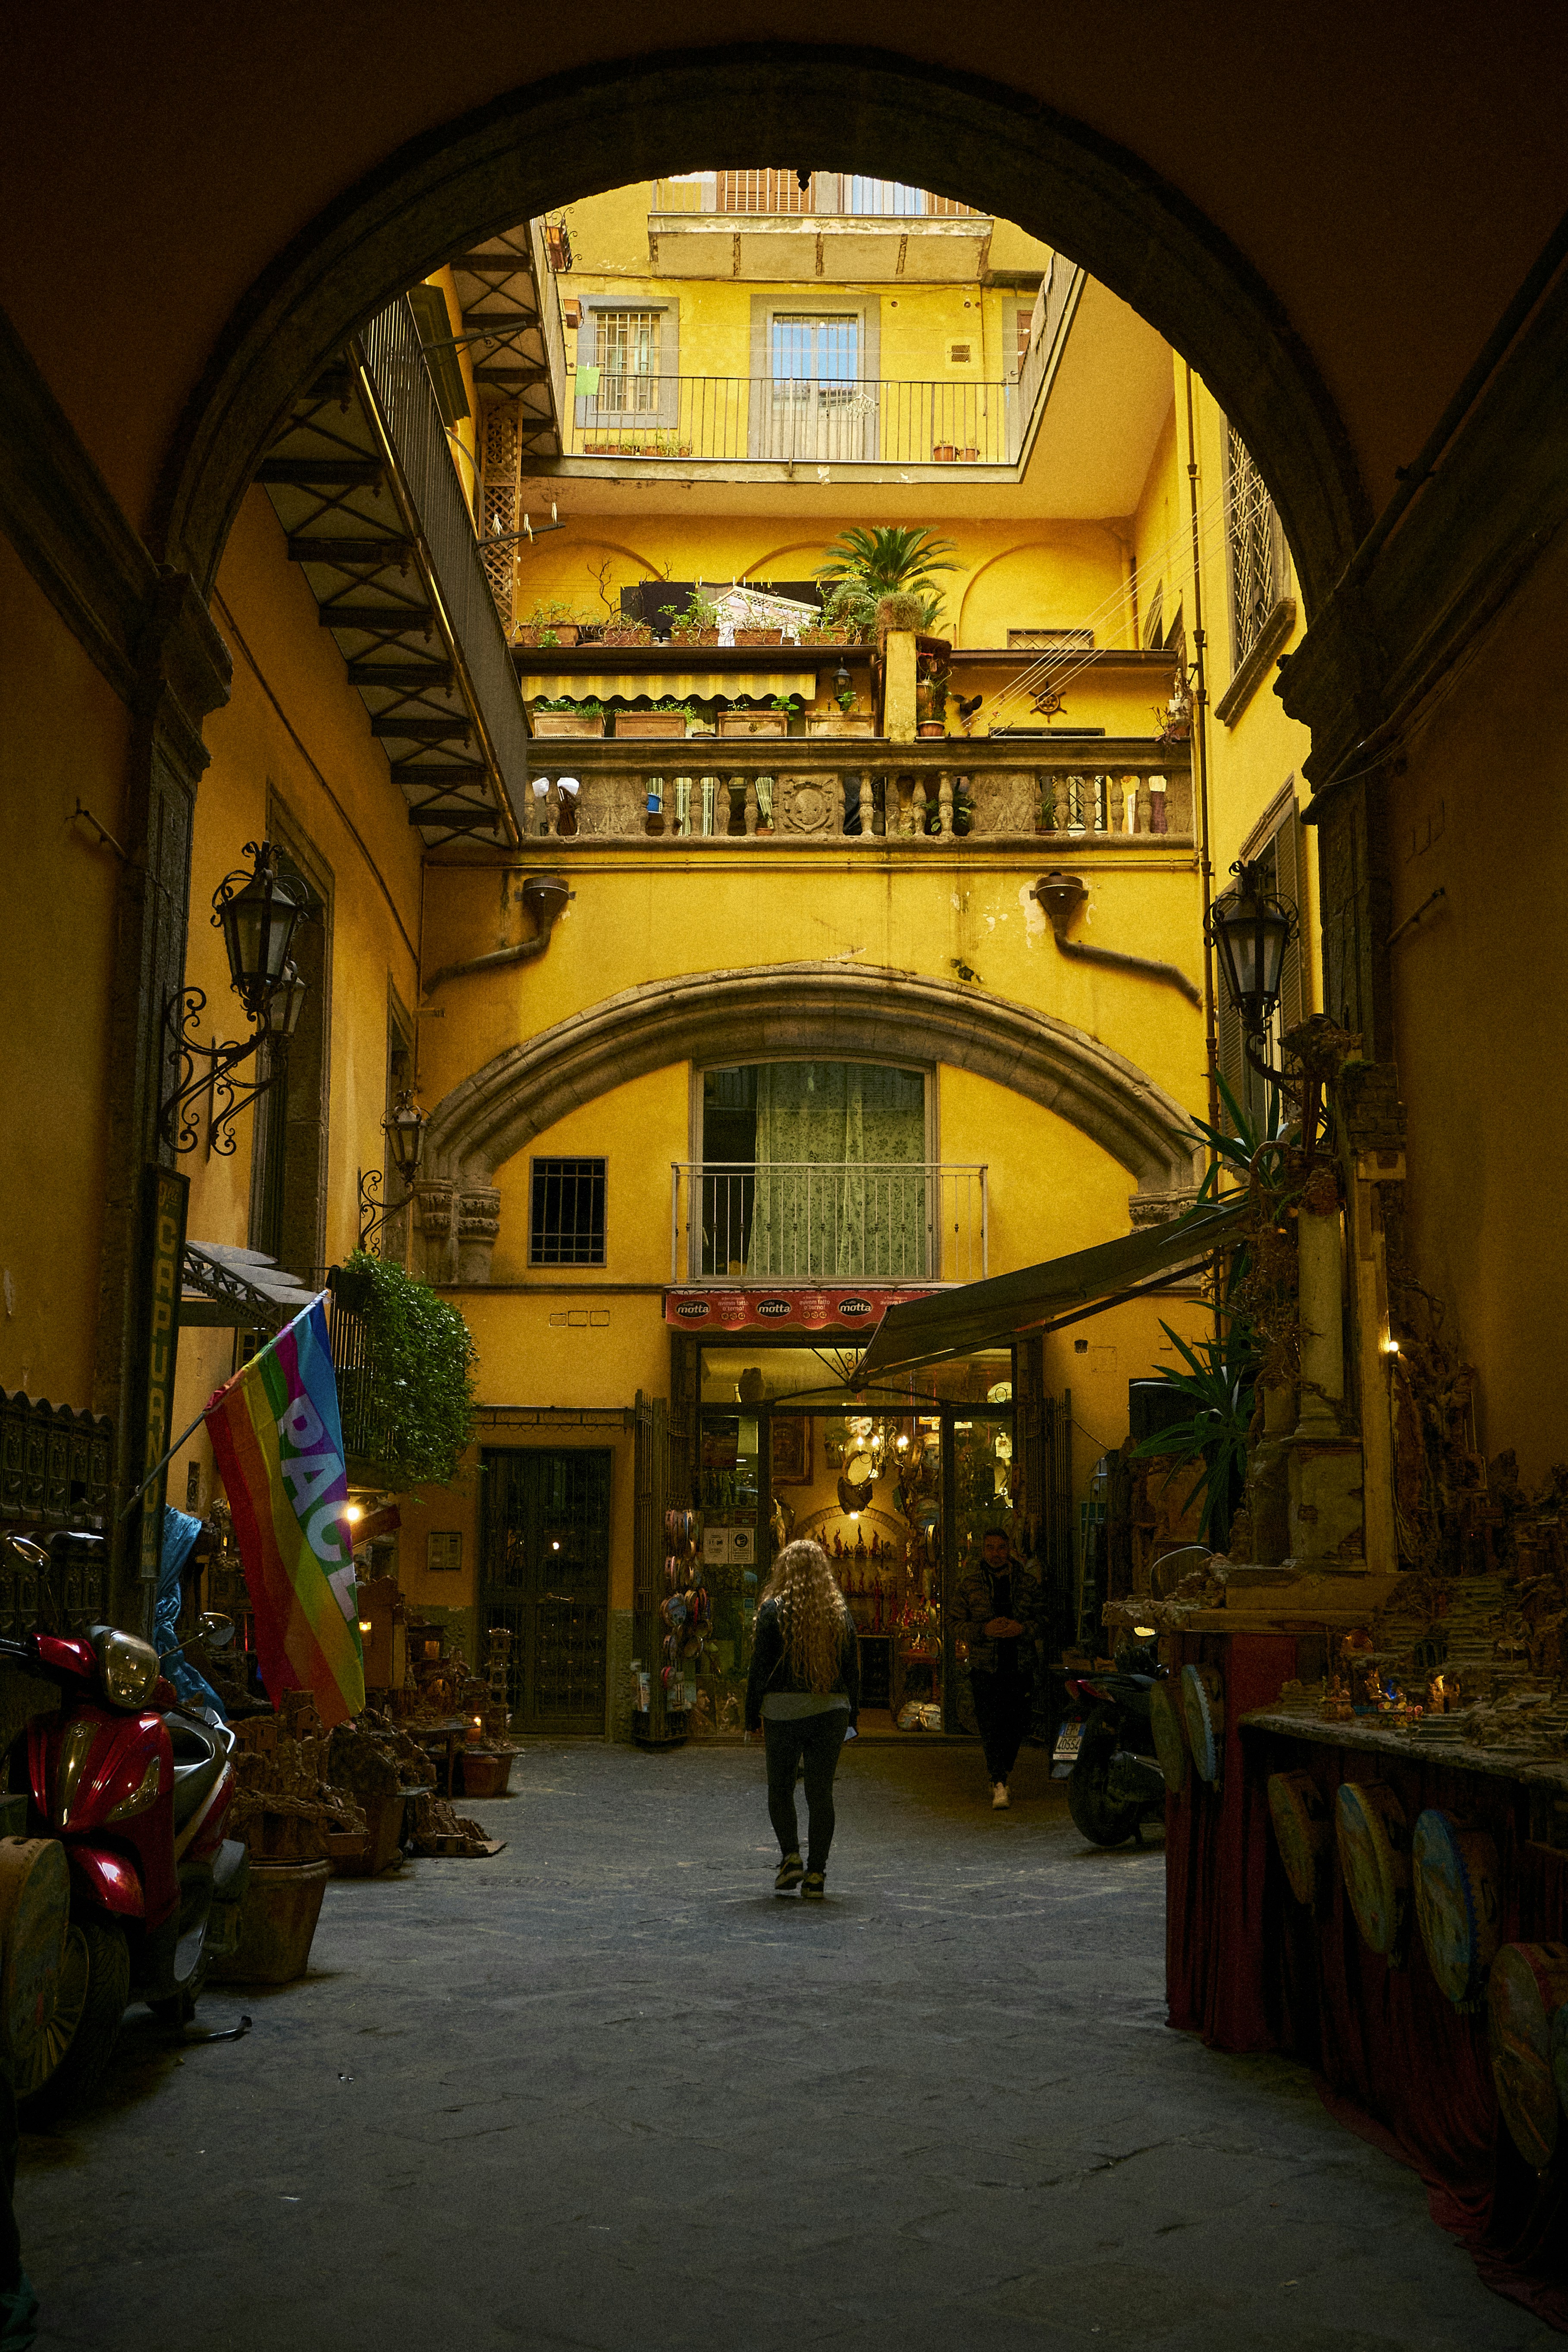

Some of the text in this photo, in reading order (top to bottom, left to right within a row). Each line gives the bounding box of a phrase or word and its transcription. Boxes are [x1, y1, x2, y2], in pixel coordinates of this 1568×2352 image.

[677, 1305, 709, 1313] motta
[759, 1304, 790, 1313] motta
[840, 1303, 871, 1312] motta
[144, 1215, 177, 1513] CAPUANO
[1057, 1739, 1080, 1750] 40554
